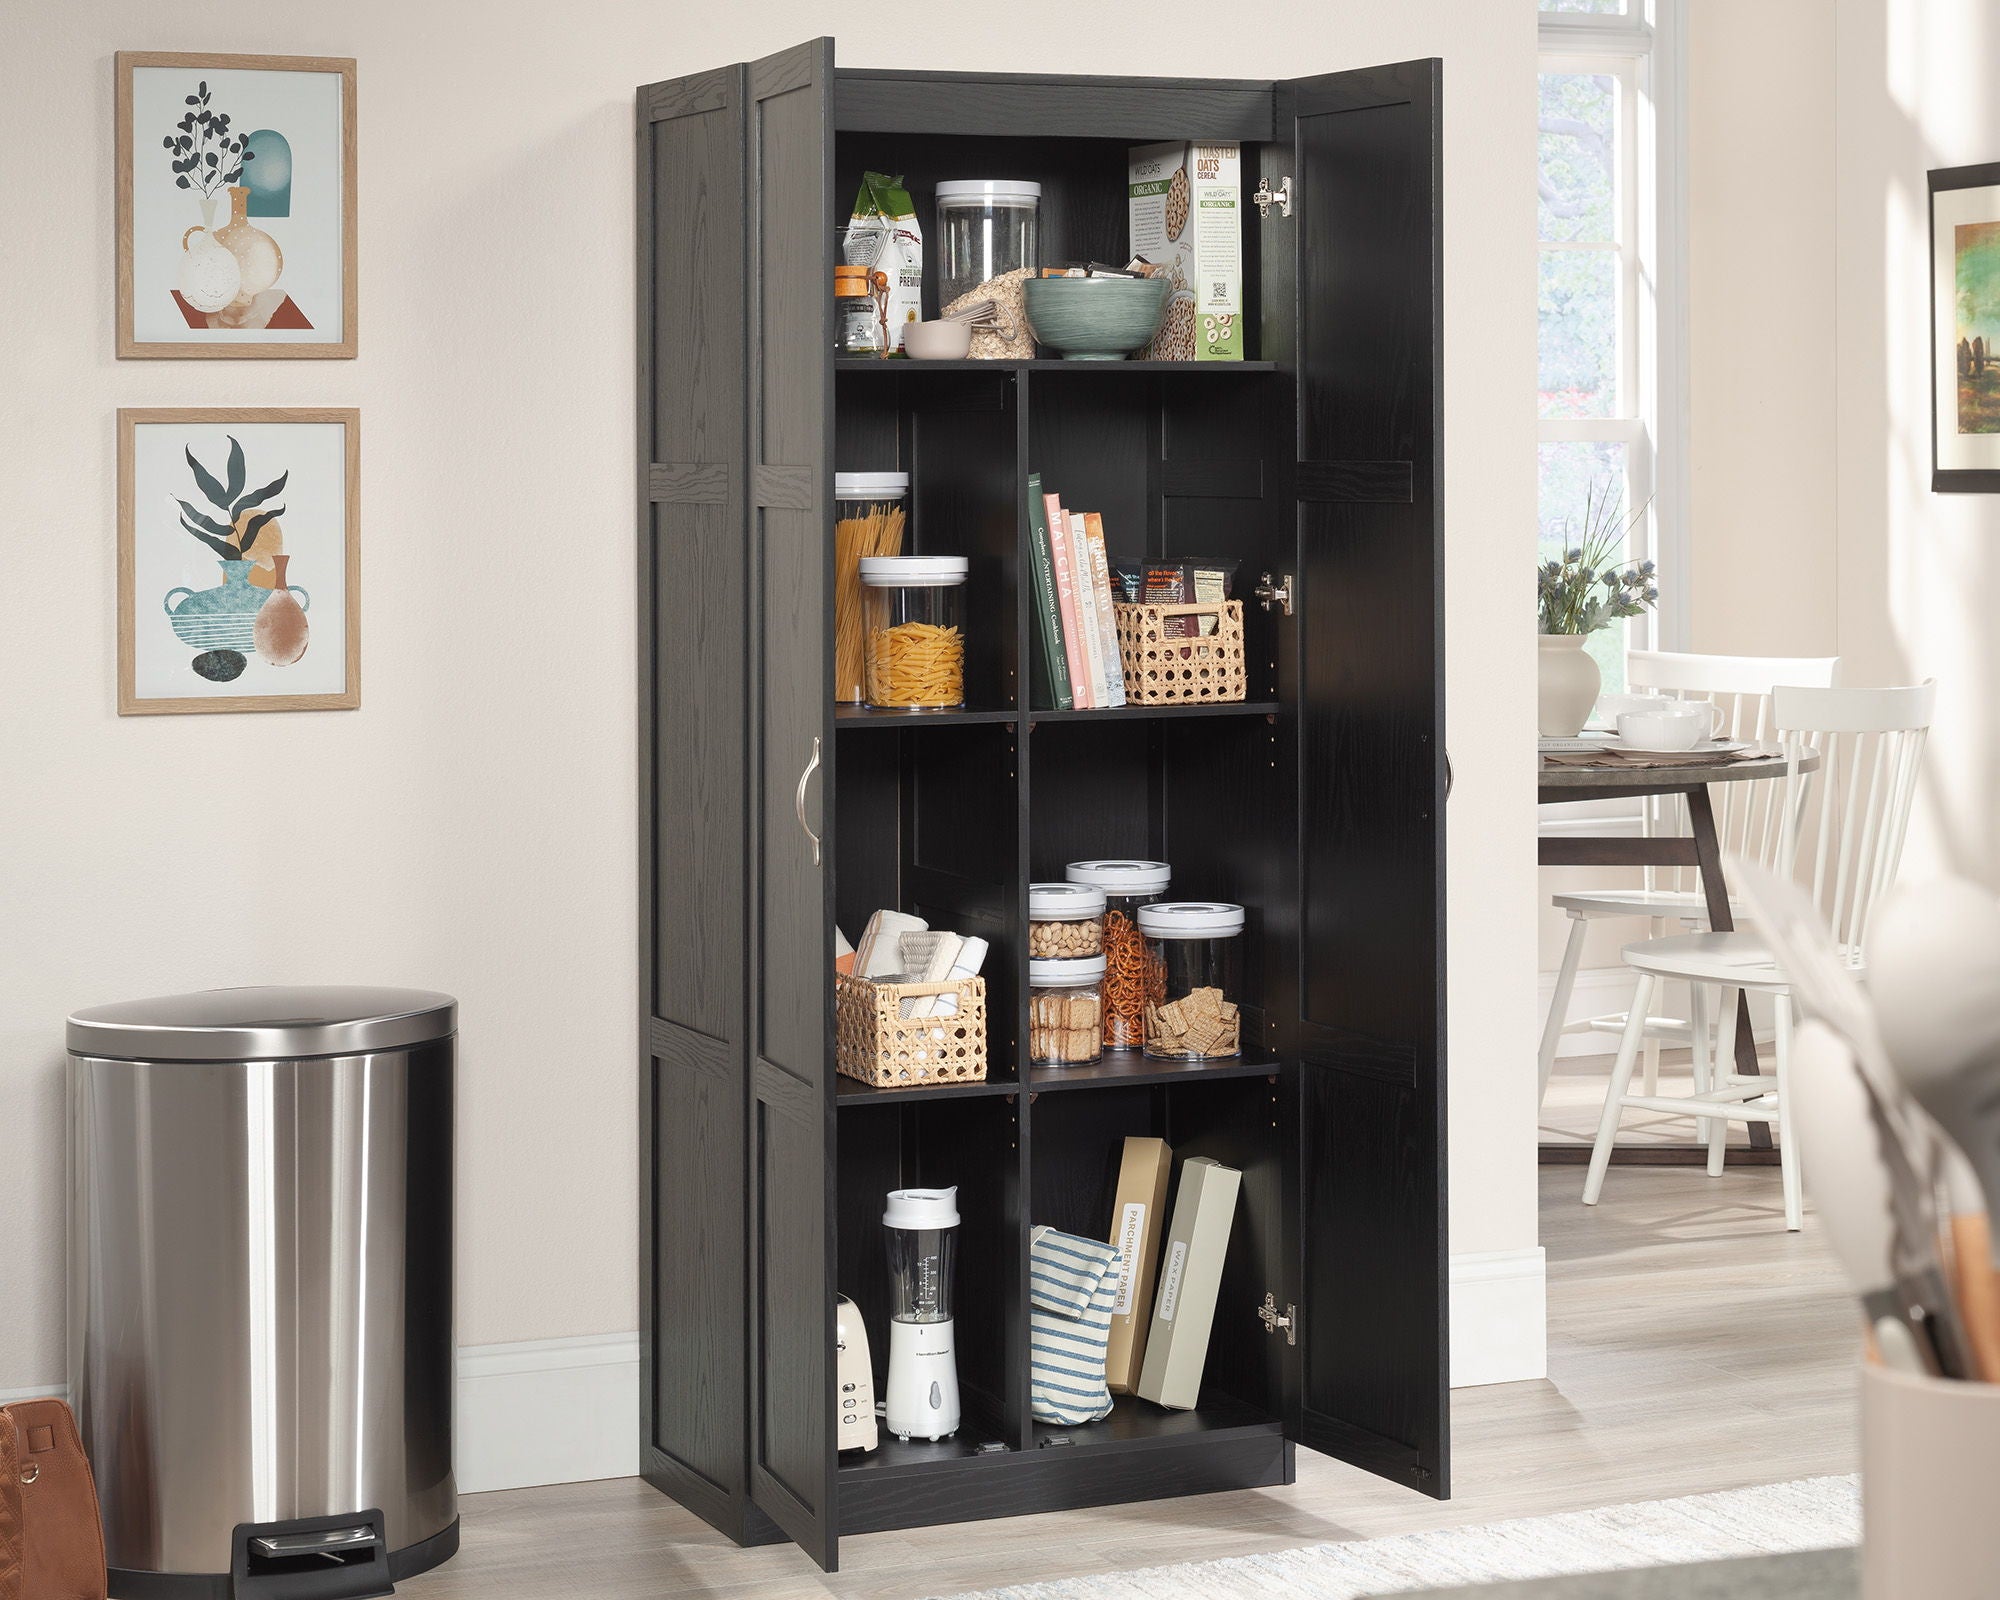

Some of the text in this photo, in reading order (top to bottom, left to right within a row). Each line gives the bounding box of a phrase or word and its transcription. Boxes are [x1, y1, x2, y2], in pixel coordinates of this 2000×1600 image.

[1197, 146, 1237, 159] TOASTED
[1197, 159, 1219, 172] OATS
[1133, 182, 1163, 196] ORGANIC
[1197, 171, 1217, 180] CEREAL
[1050, 511, 1072, 598] MATCHA
[1038, 527, 1046, 556] Complete
[1050, 614, 1061, 645] Cookbook
[1116, 1210, 1138, 1308] PARCHMENT PAPER
[1165, 1250, 1182, 1312] WAX PAPER
